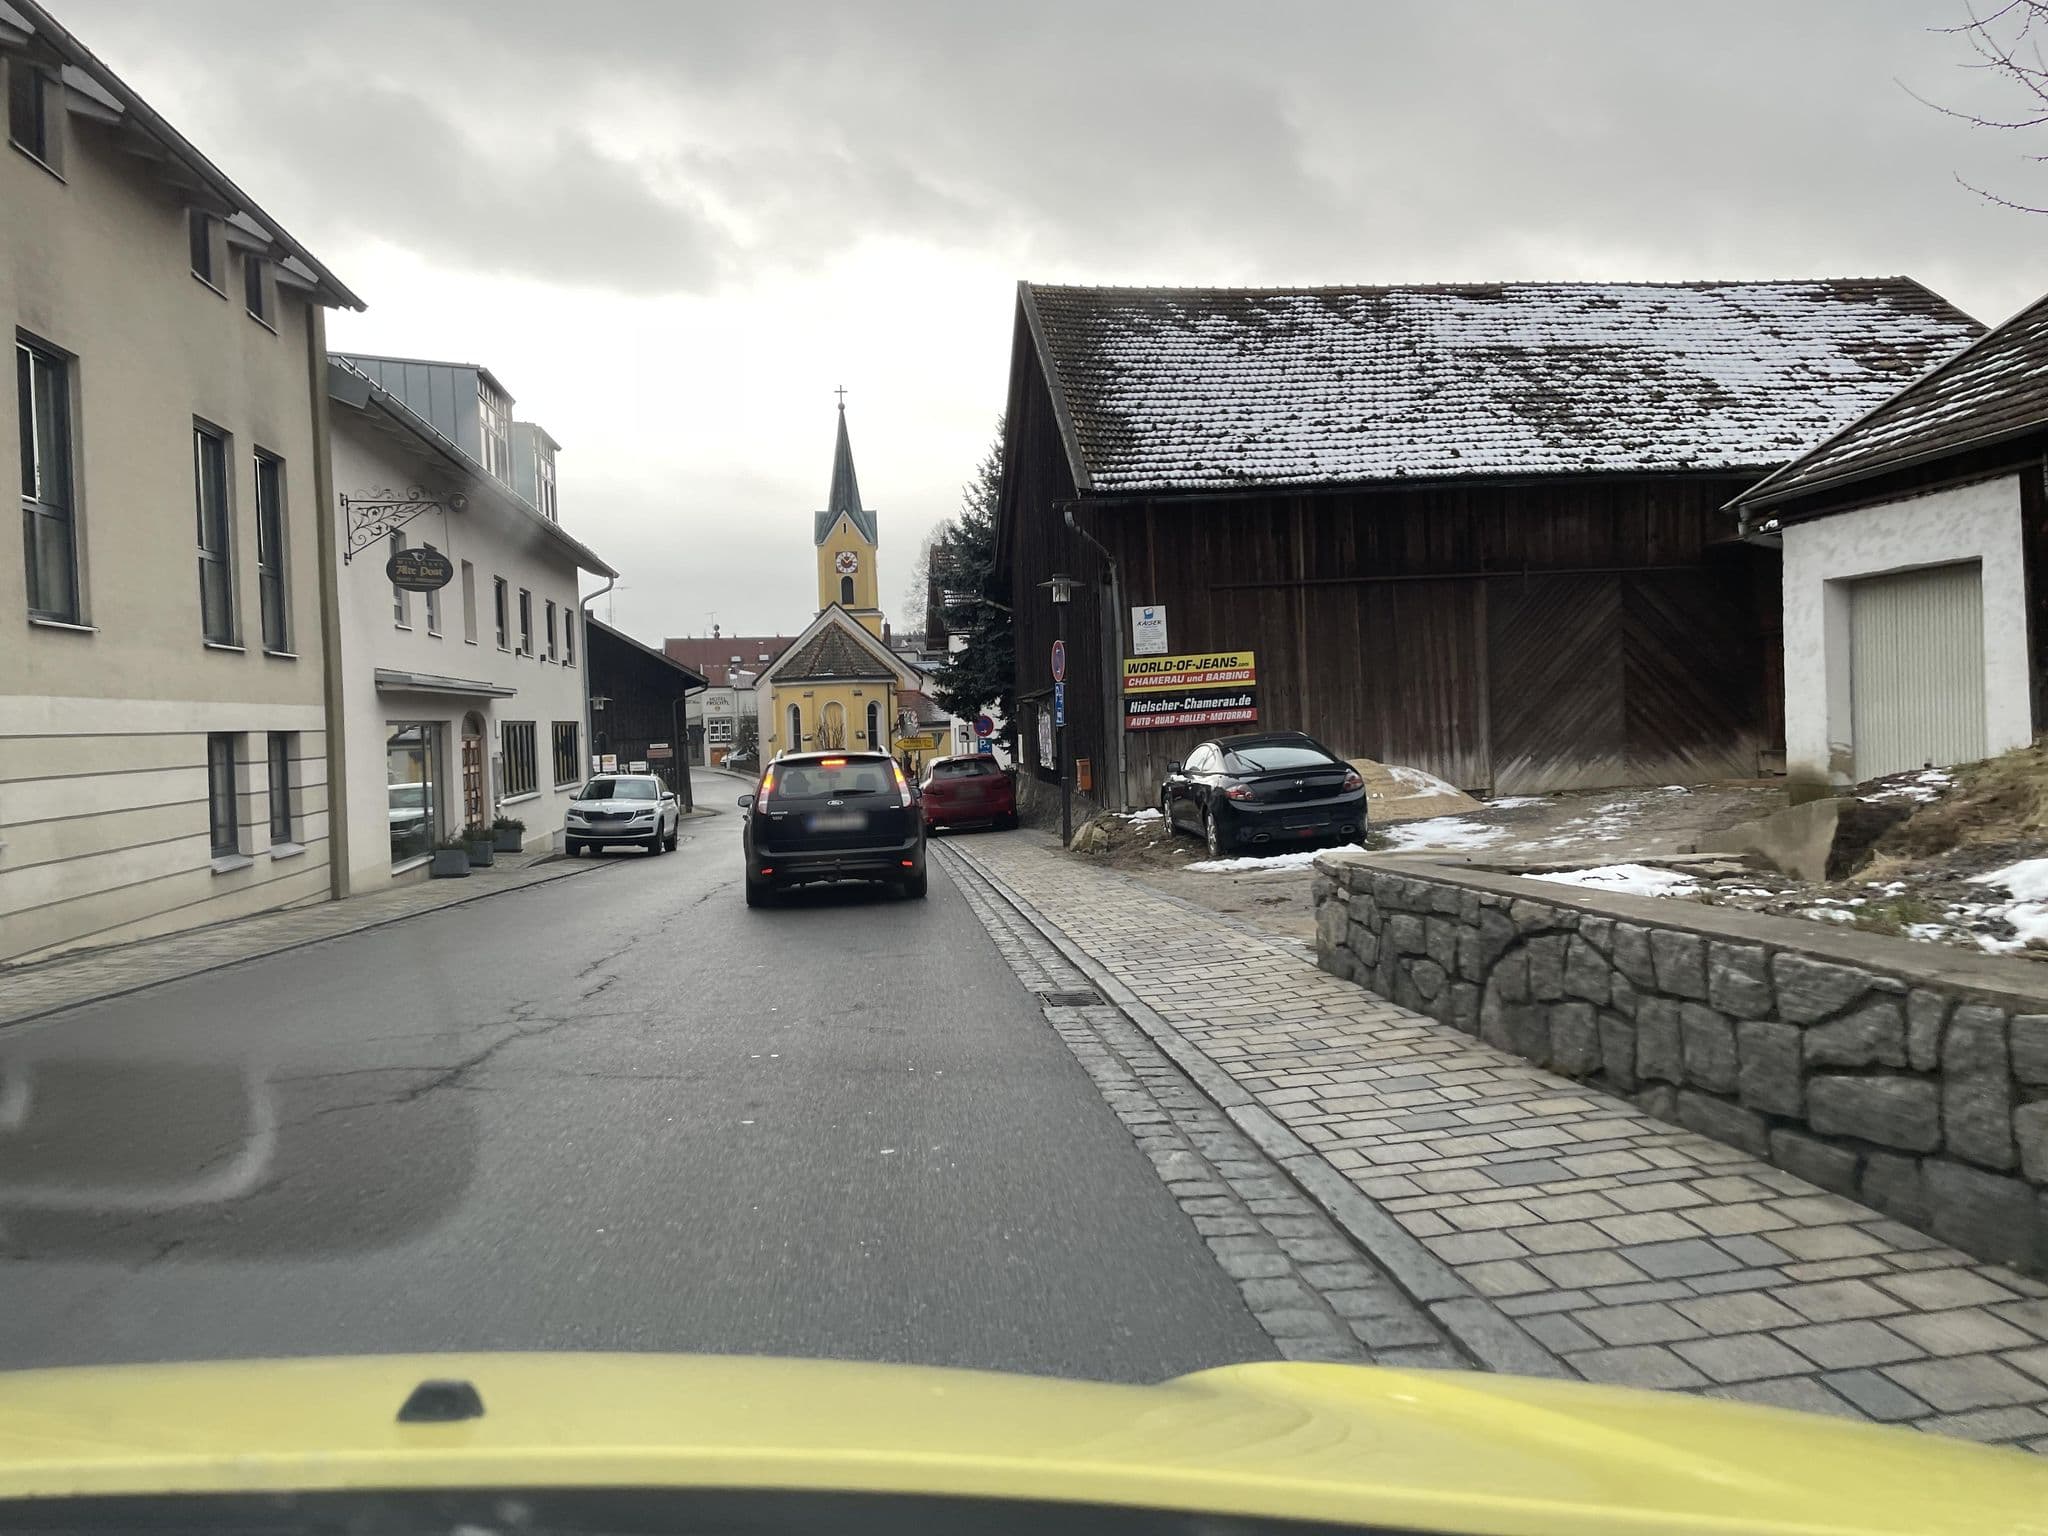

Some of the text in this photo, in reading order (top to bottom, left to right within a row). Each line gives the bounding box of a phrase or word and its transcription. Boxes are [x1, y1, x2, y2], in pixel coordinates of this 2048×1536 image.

[1128, 670, 1250, 687] CHAMERAU und BARBING
[1130, 694, 1252, 714] Hielscher-Chamerau.de
[1130, 710, 1252, 727] AUTO QUAD ROLLER MOTORRAD
[980, 740, 986, 750] P
